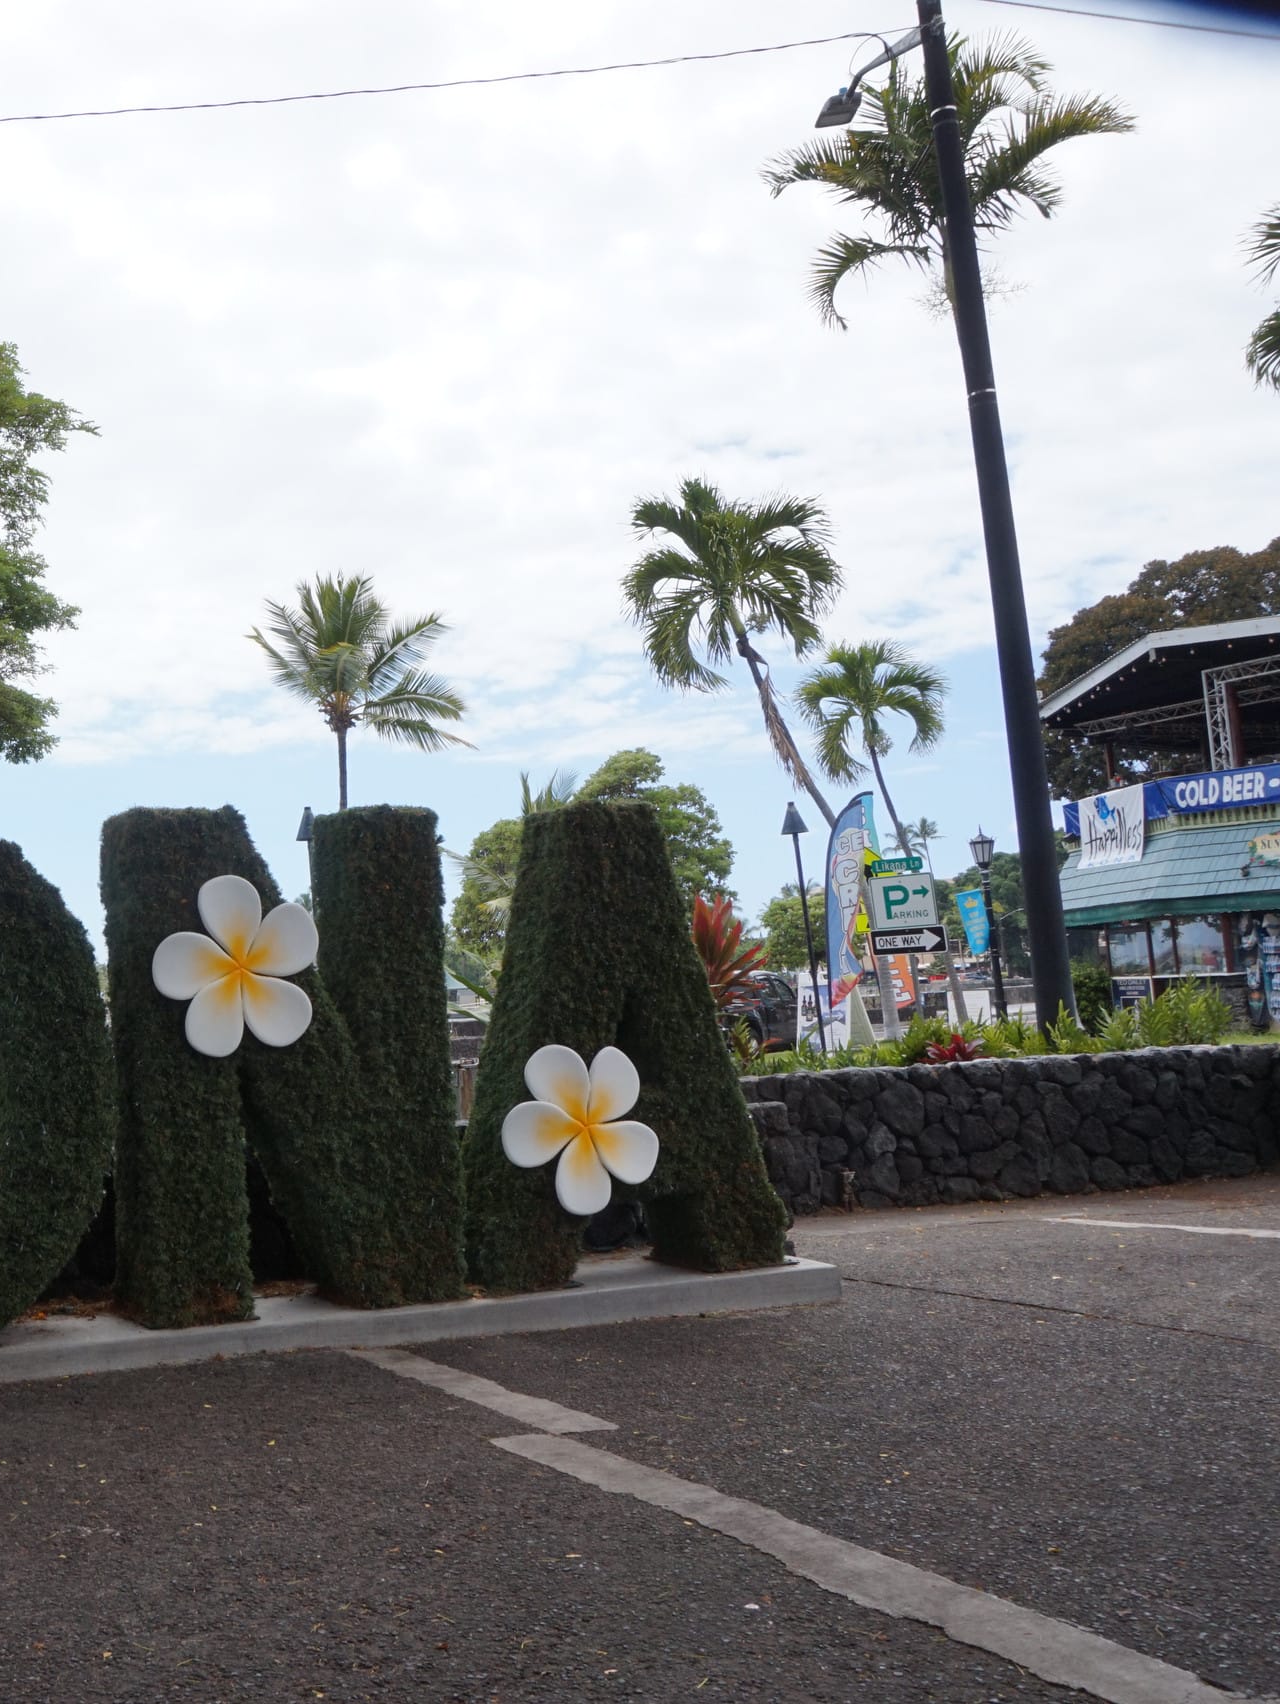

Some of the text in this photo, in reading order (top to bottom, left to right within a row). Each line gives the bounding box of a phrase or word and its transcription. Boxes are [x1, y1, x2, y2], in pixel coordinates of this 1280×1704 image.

[1175, 772, 1265, 808] COLD BEER
[875, 860, 920, 873] Likana Ln
[878, 936, 922, 948] ONE WAY
